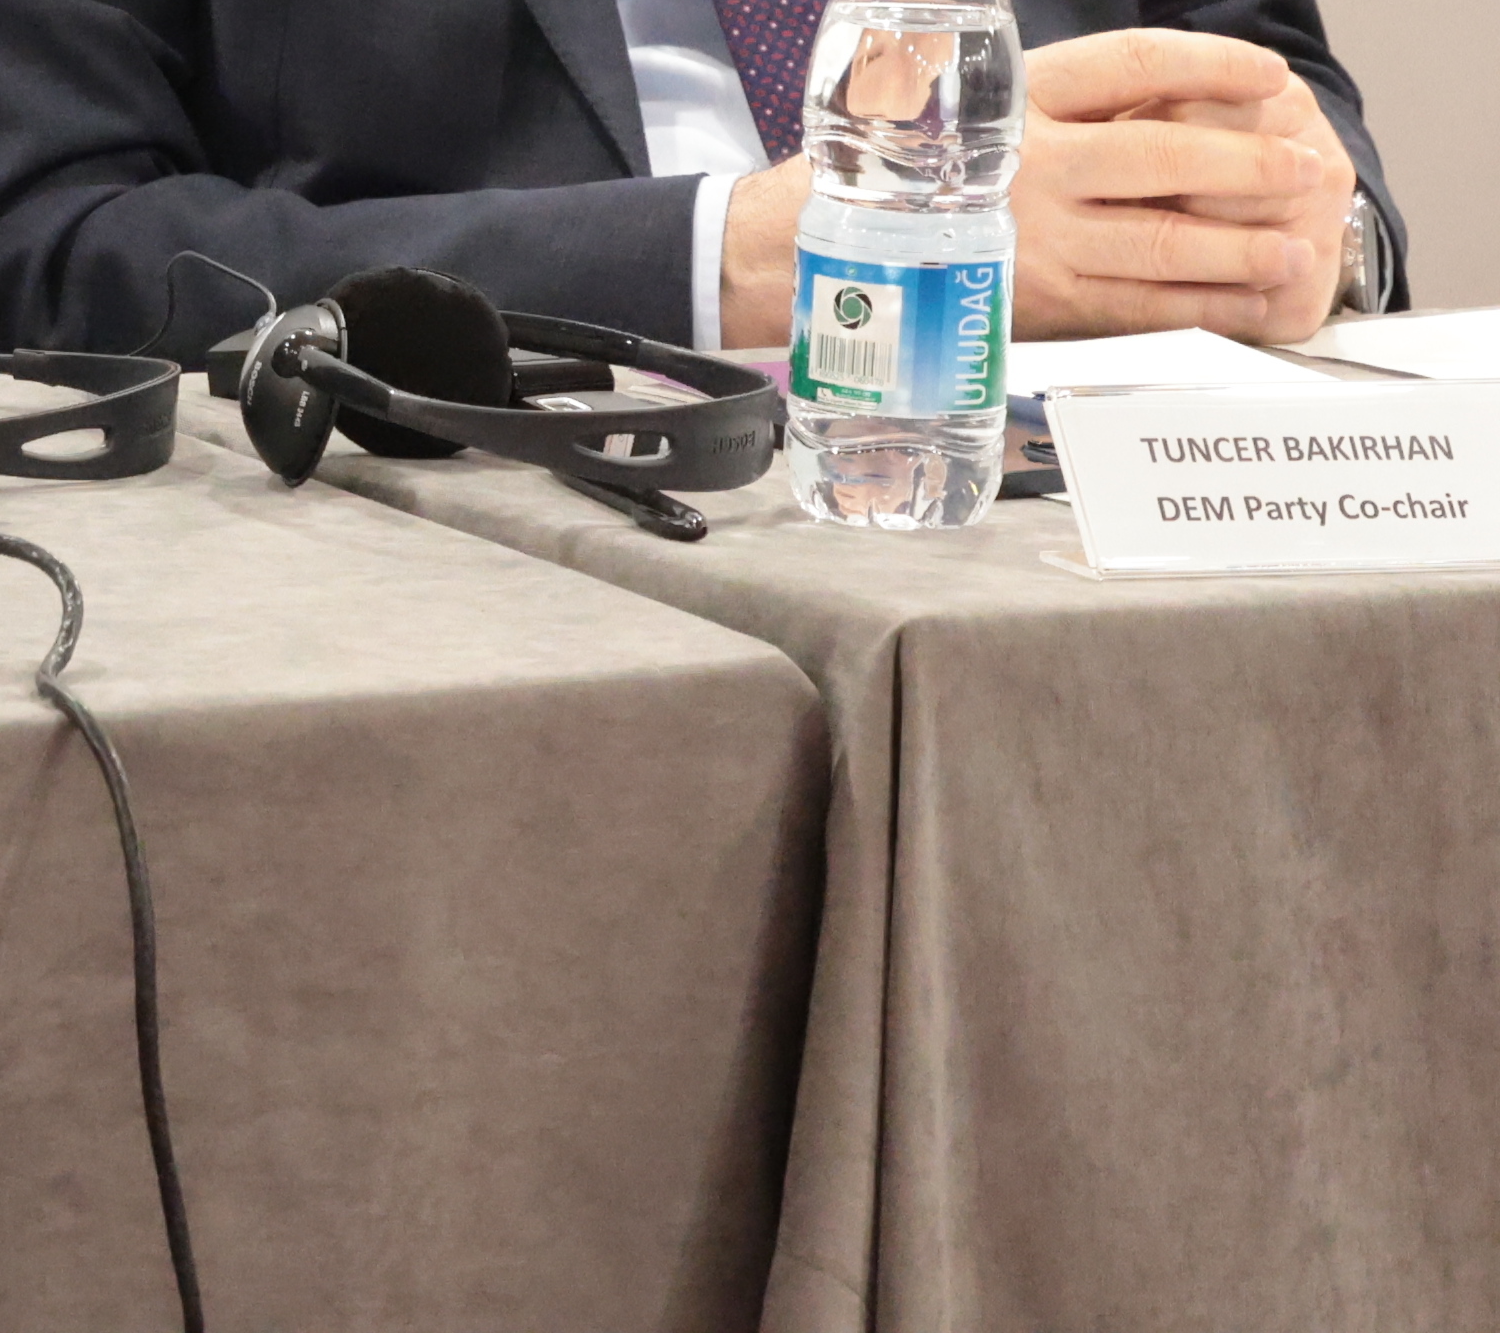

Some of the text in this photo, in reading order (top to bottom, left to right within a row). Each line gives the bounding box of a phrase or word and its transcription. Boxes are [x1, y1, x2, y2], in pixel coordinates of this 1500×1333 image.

[954, 266, 994, 406] ULUDAĞ
[1140, 434, 1455, 464] TUNCER BAKIRHAN
[1157, 492, 1469, 527] DEM Party Co-chair
